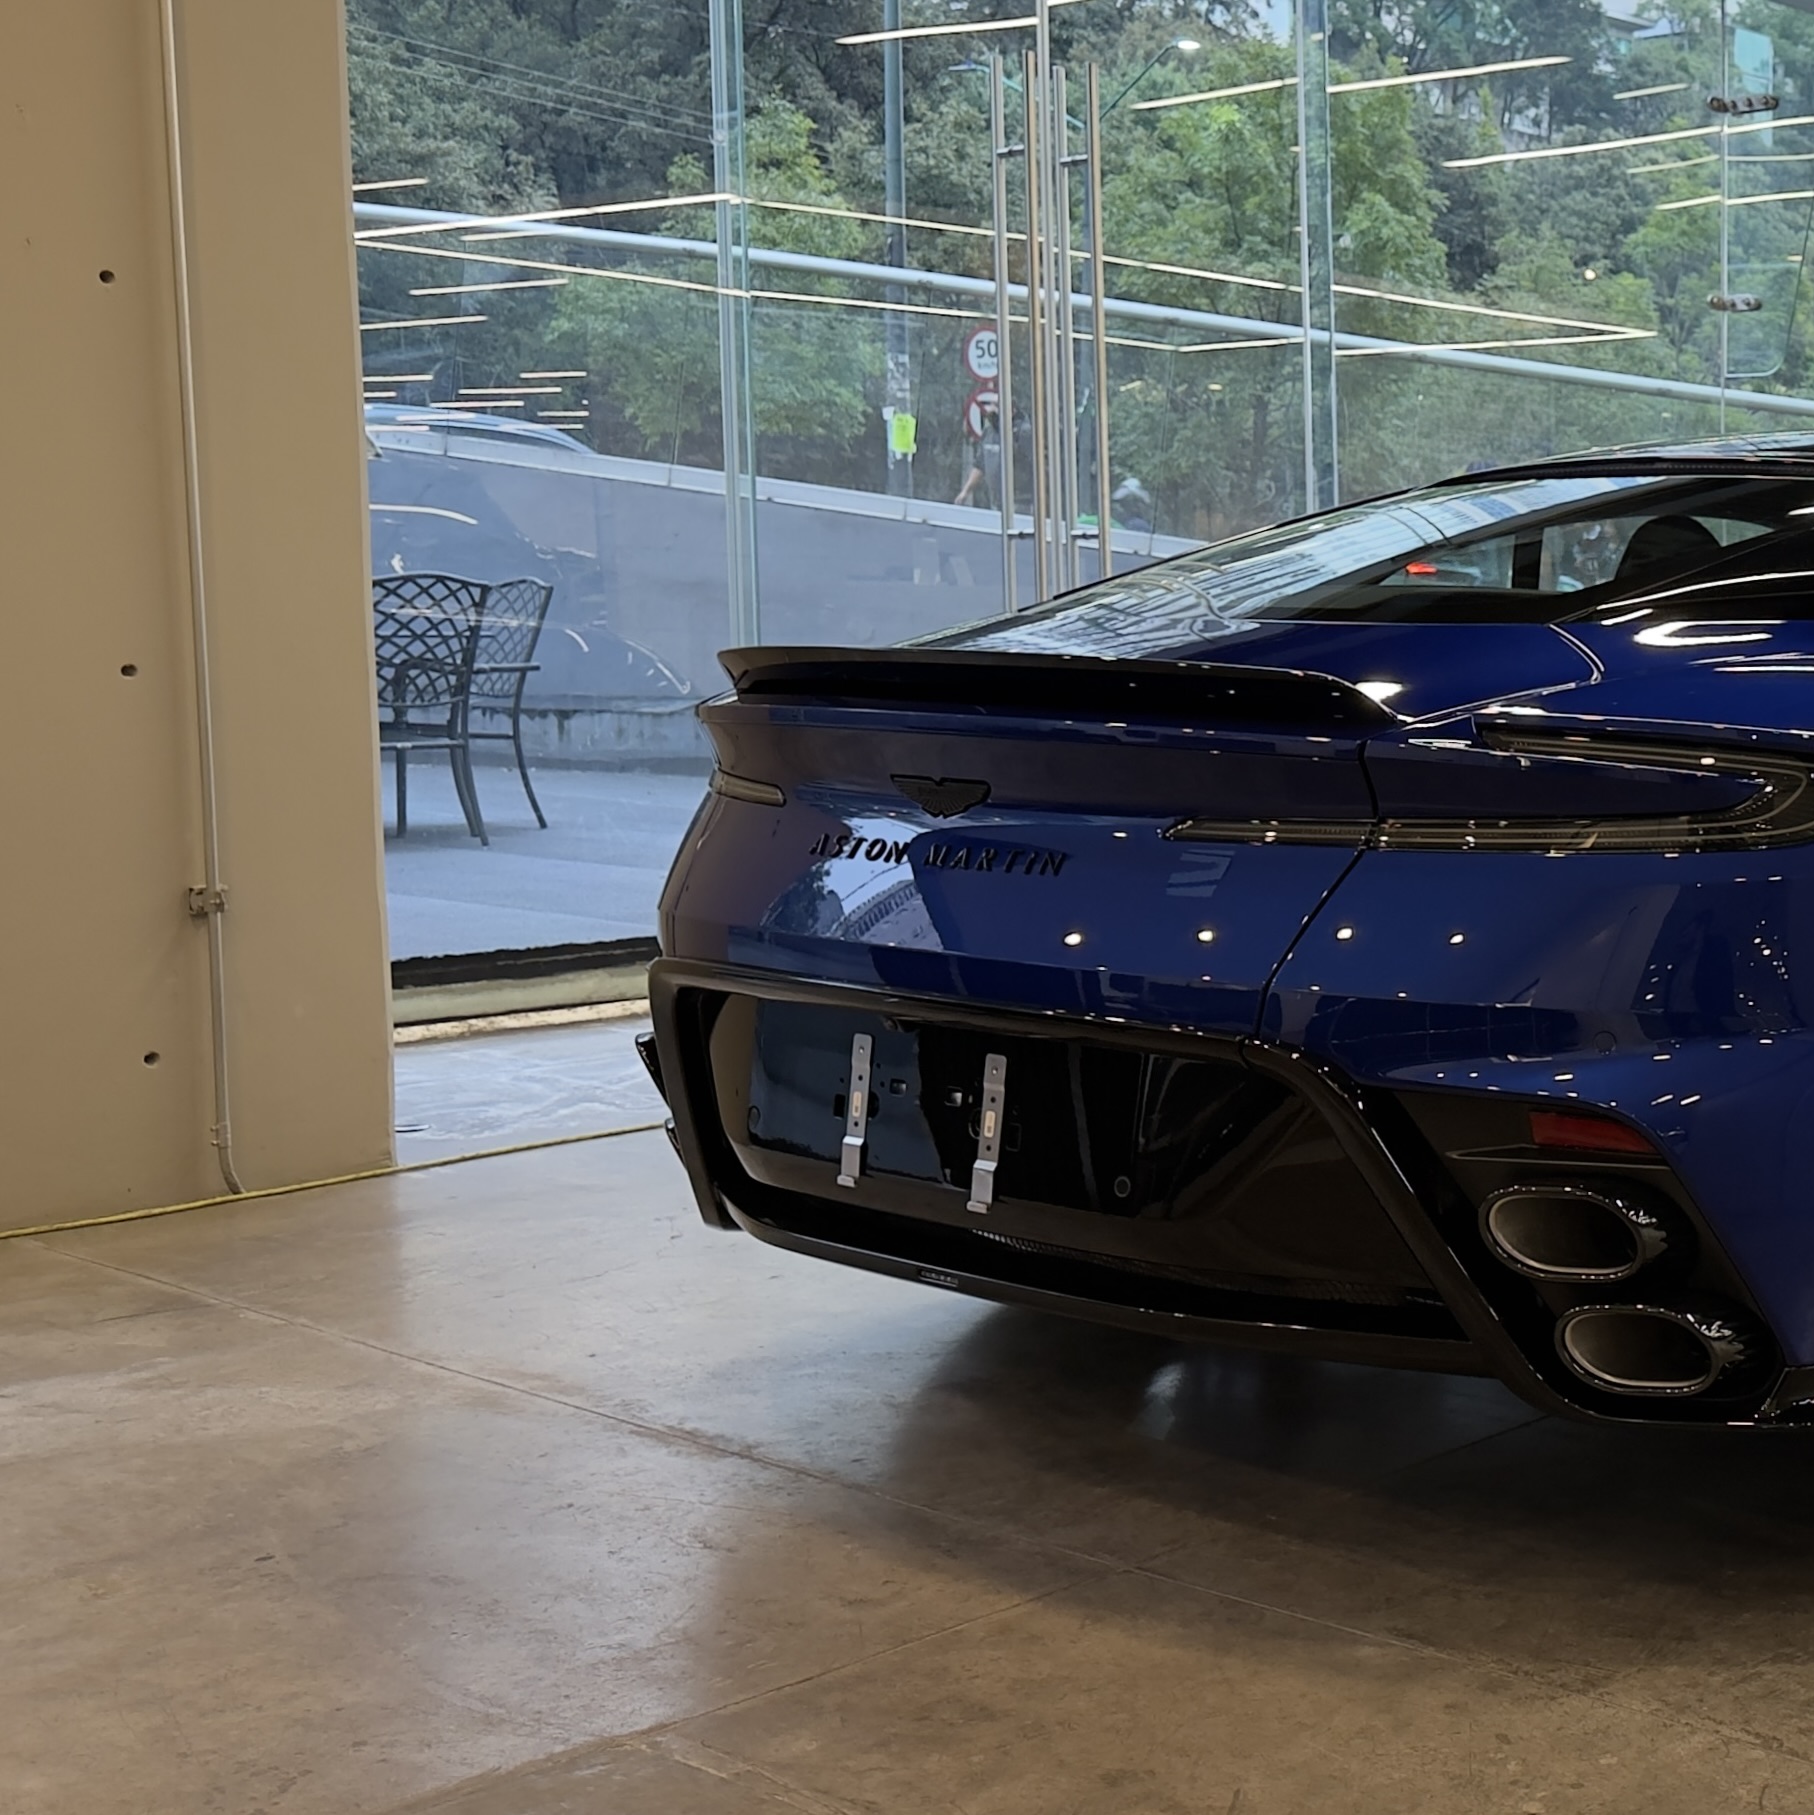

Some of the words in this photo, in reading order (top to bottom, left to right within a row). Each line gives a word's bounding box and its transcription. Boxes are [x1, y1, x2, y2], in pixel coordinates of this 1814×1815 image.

[975, 339, 998, 359] 50
[809, 833, 910, 865] ASTON
[923, 843, 1069, 878] MARTIN
